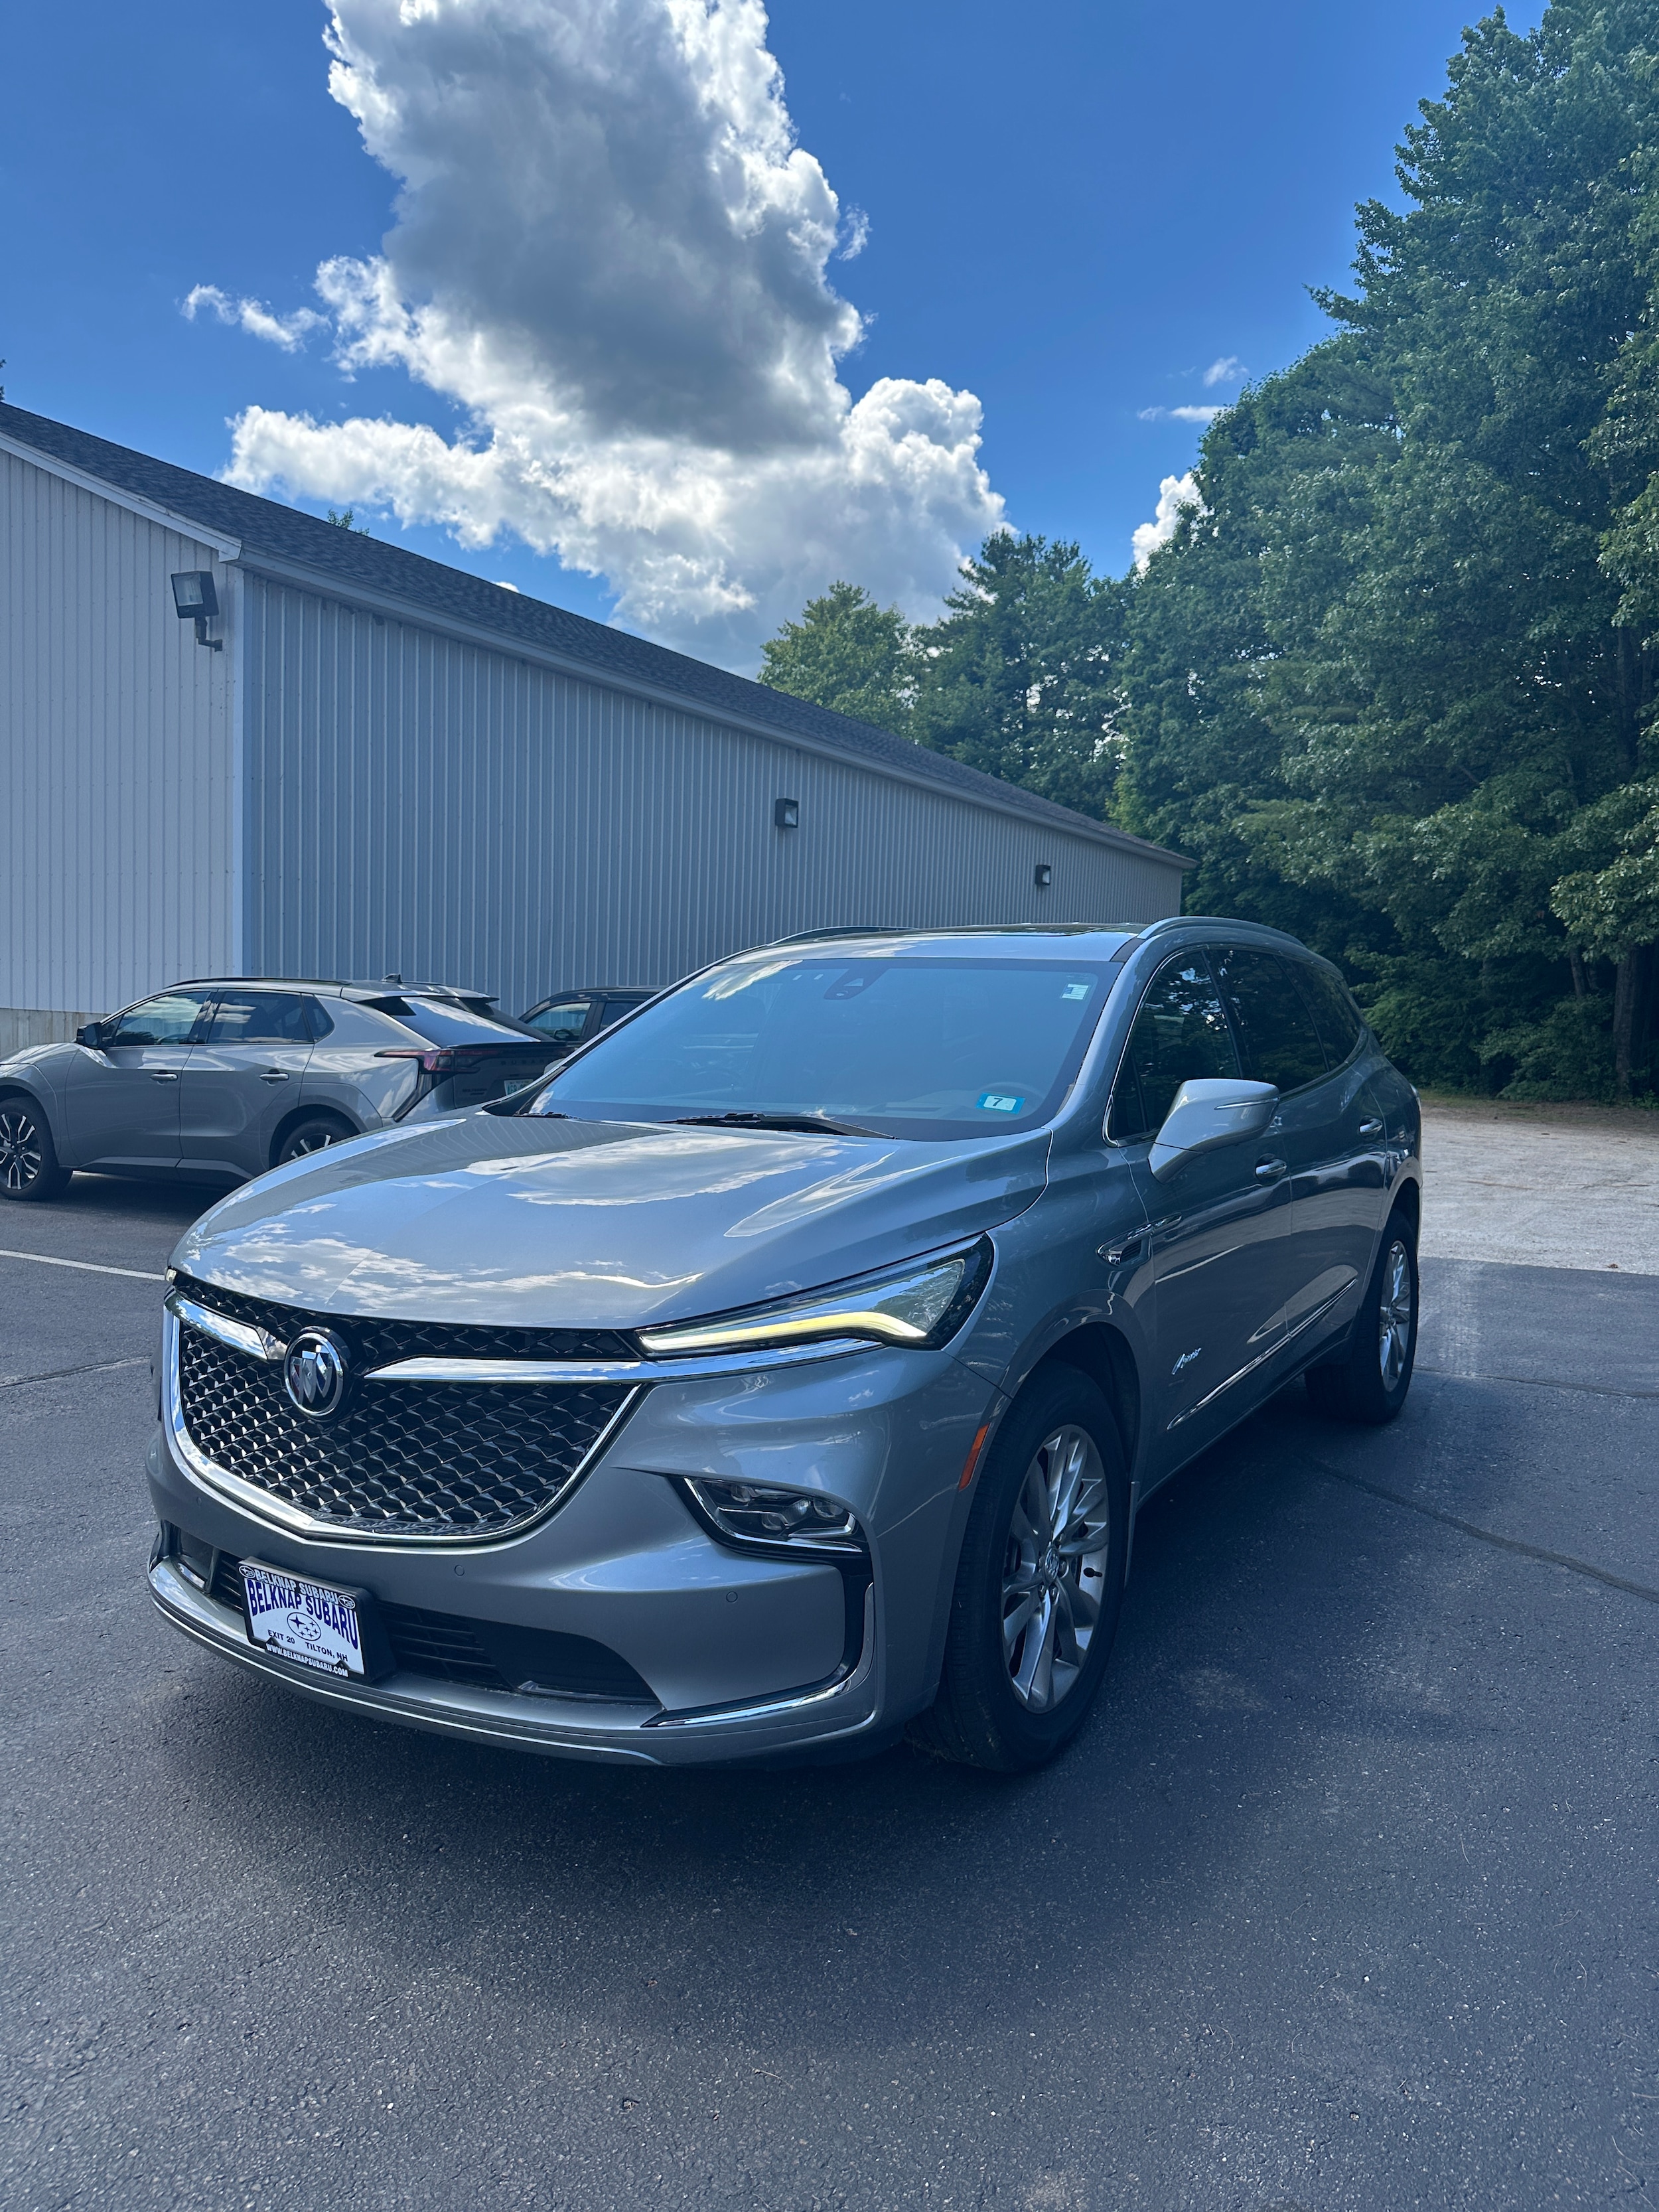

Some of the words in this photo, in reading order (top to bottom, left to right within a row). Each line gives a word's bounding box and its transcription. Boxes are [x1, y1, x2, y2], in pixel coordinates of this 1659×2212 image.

[993, 1097, 1003, 1106] 7
[254, 1569, 297, 1591] BELKNAP
[299, 1582, 339, 1605] SUBARU
[247, 1579, 302, 1617] BELKNAP
[305, 1594, 358, 1650] SUBARU
[267, 1629, 284, 1641] EXIT
[286, 1635, 295, 1645] 20
[265, 1643, 348, 1678] WWW.BELKNAPSUBARU.COM
[305, 1641, 335, 1659] TILTON,
[336, 1651, 348, 1662] NH
